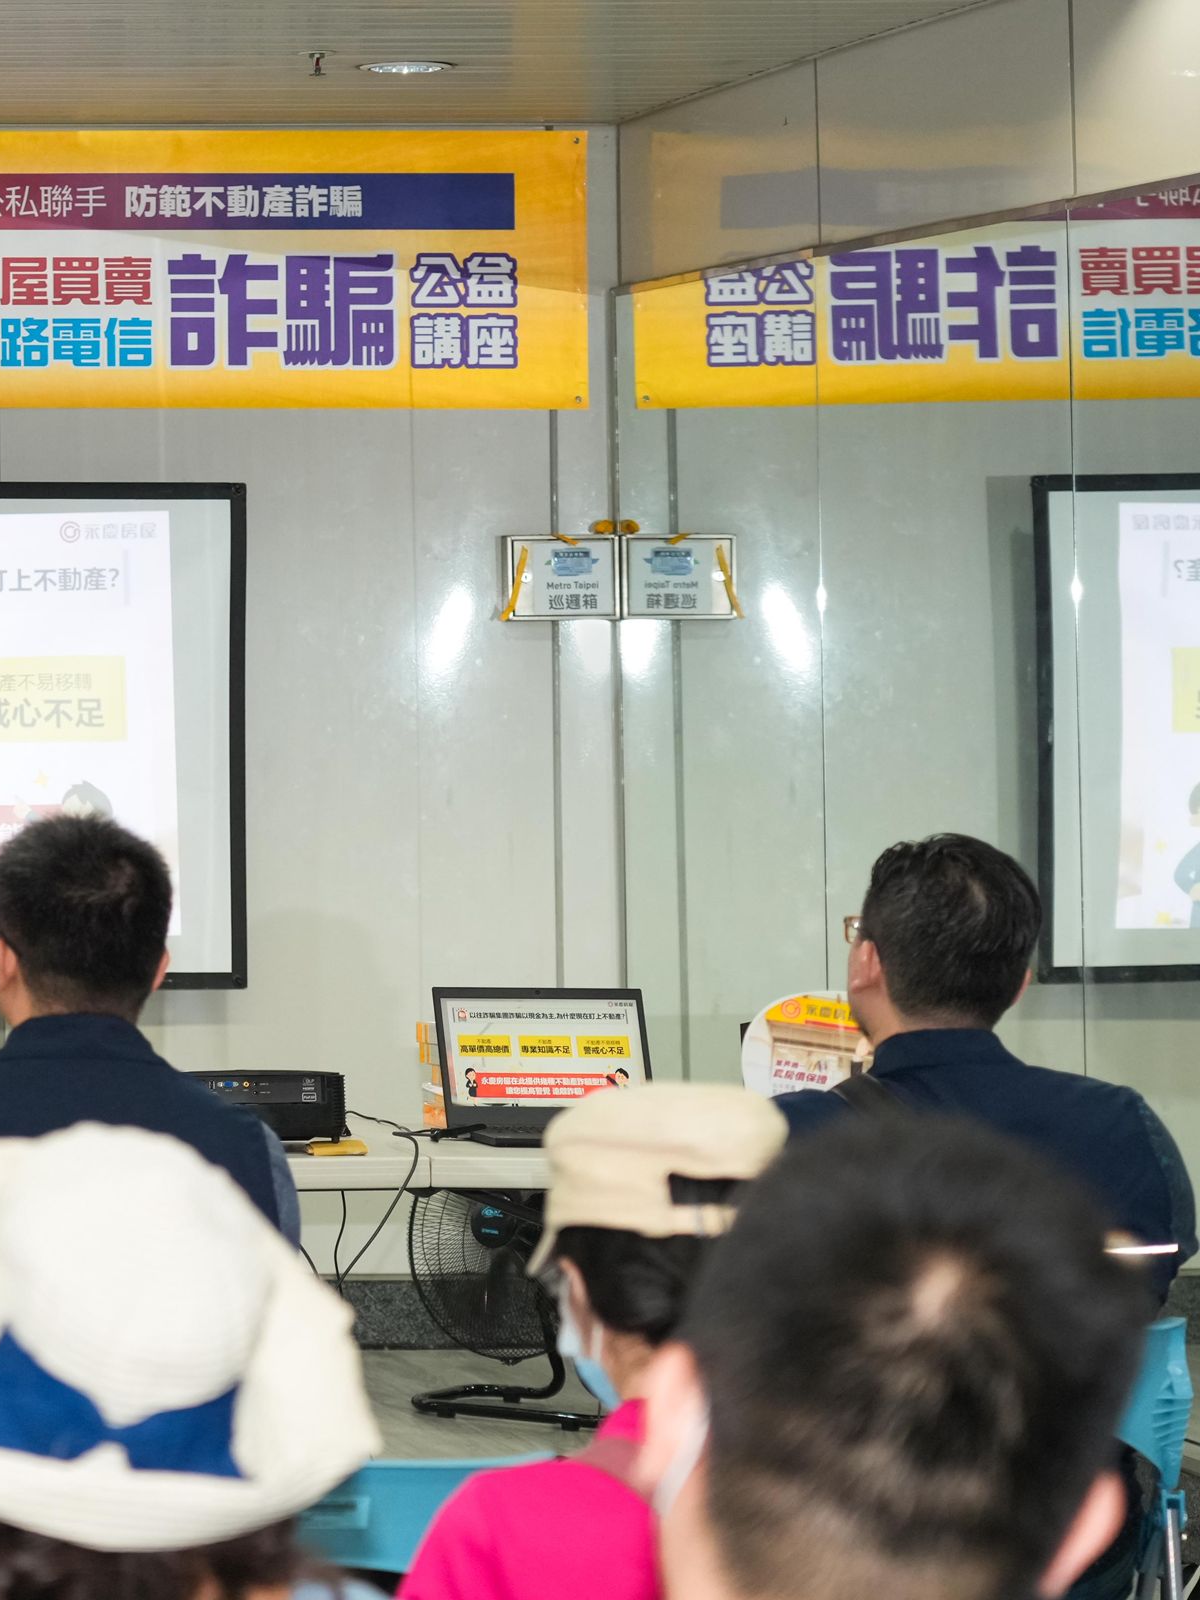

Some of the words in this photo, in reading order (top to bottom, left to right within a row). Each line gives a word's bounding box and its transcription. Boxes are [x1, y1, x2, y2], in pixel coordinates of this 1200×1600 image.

[125, 184, 363, 218] 防範不動產詐騙
[411, 253, 517, 307] 公益
[167, 253, 395, 367] 詐騙
[411, 314, 518, 368] 講座
[546, 582, 571, 590] Metro
[574, 580, 599, 590] Taipei
[548, 593, 598, 610] 巡邏箱
